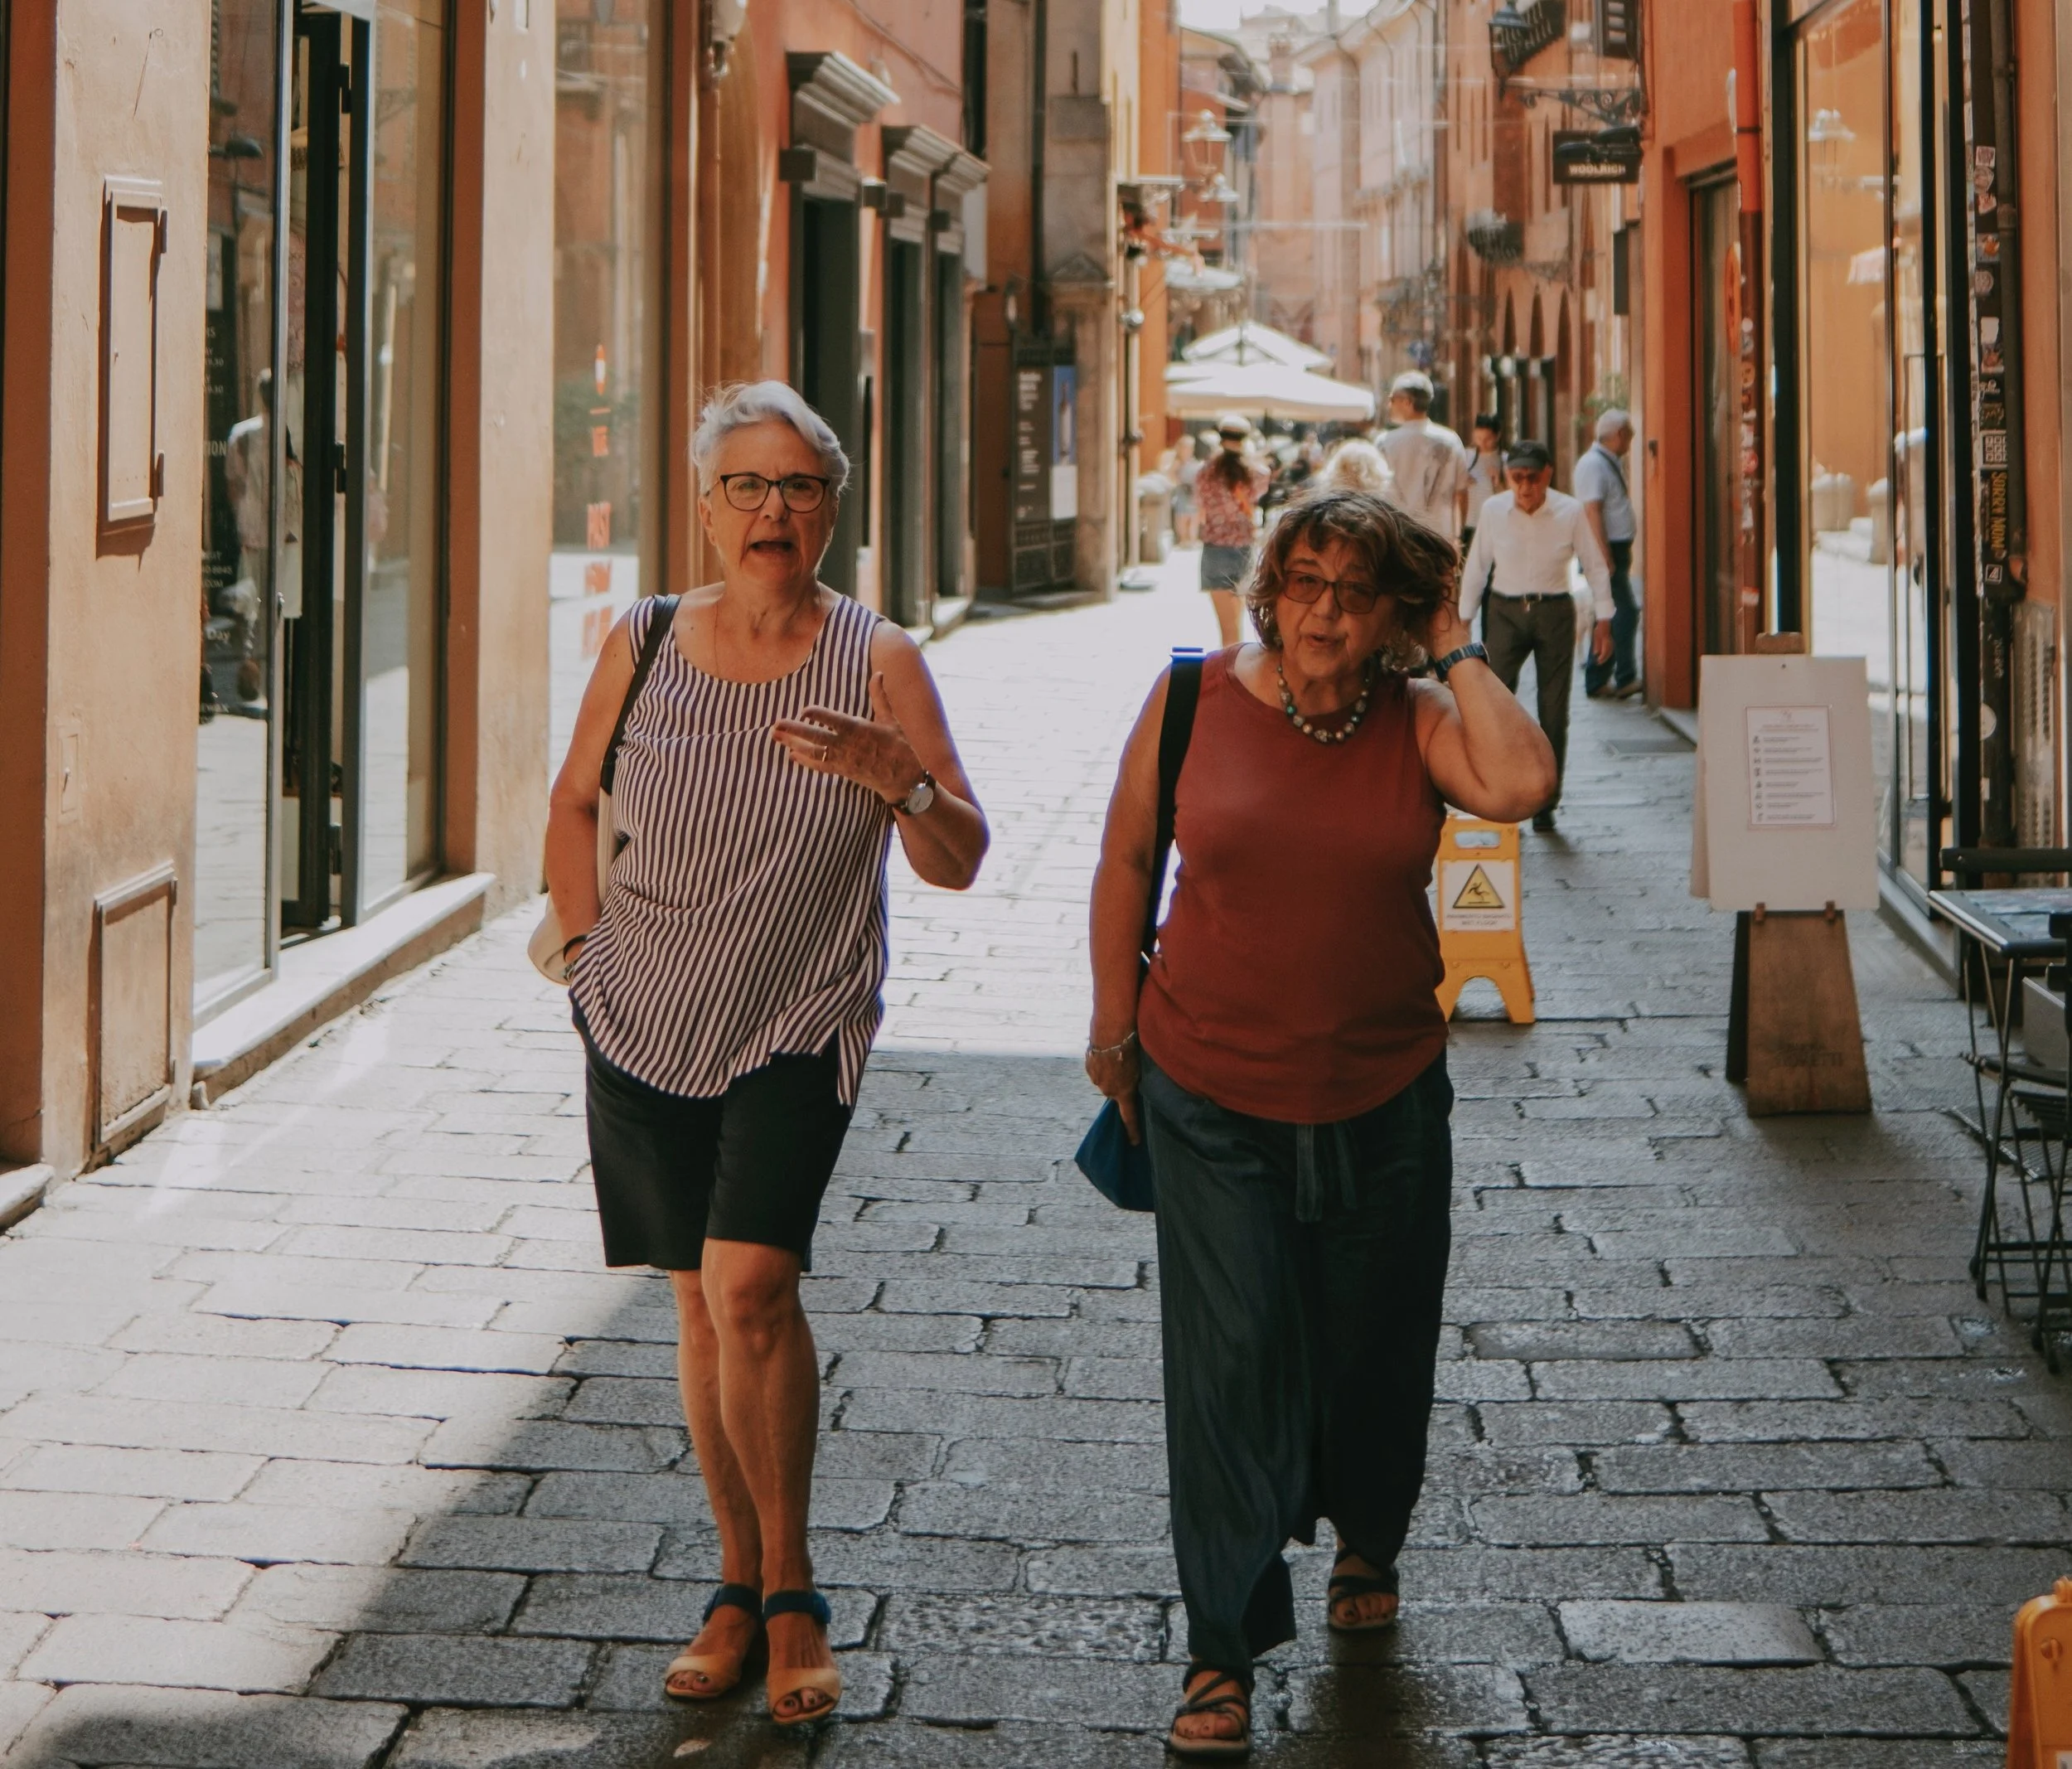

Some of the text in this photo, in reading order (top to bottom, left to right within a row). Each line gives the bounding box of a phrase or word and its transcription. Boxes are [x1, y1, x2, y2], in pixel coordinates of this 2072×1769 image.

[1568, 163, 1626, 177] WOOLRICH
[1991, 471, 2007, 513] SORRY
[1990, 516, 2007, 549] MOM
